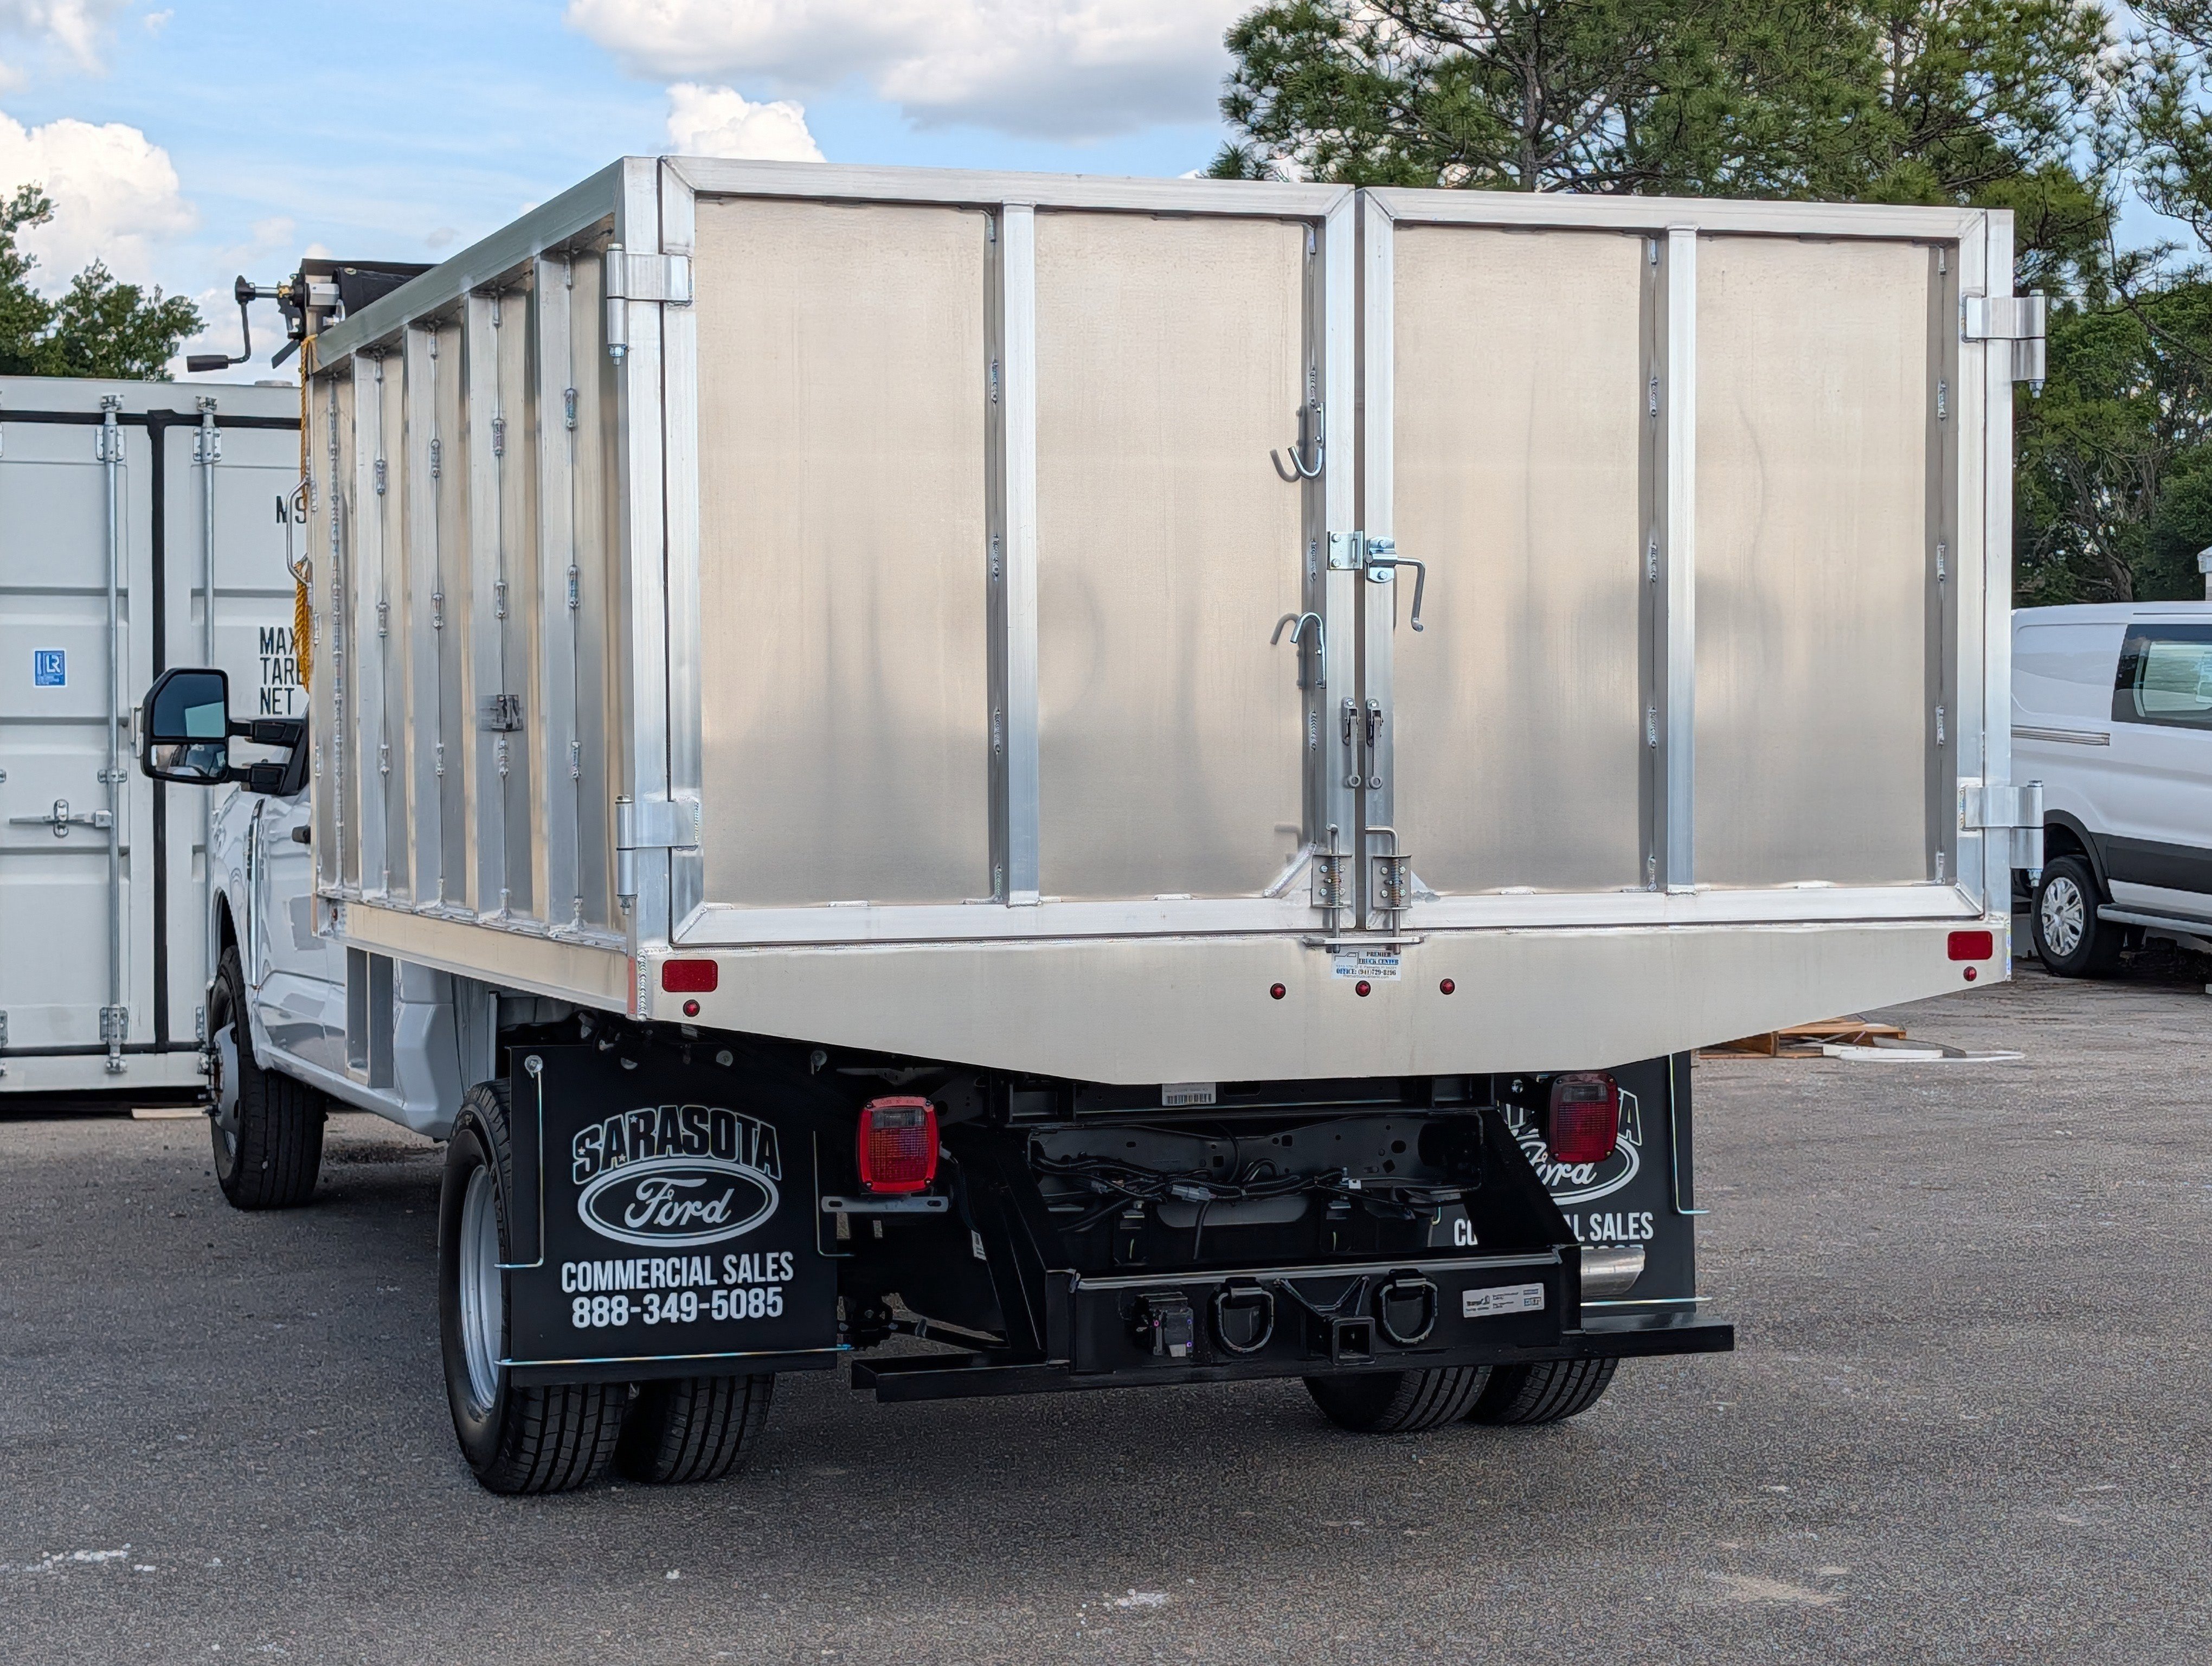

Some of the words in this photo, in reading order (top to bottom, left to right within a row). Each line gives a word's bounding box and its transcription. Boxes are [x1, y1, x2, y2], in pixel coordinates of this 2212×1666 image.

[260, 687, 295, 715] NET
[573, 1104, 782, 1185] SARASOTA
[624, 1177, 735, 1228] Ford
[1590, 1212, 1654, 1241] SALES
[561, 1255, 718, 1293] COMMERCIAL
[723, 1251, 794, 1285] SALES
[572, 1287, 783, 1328] 888-349-5085
